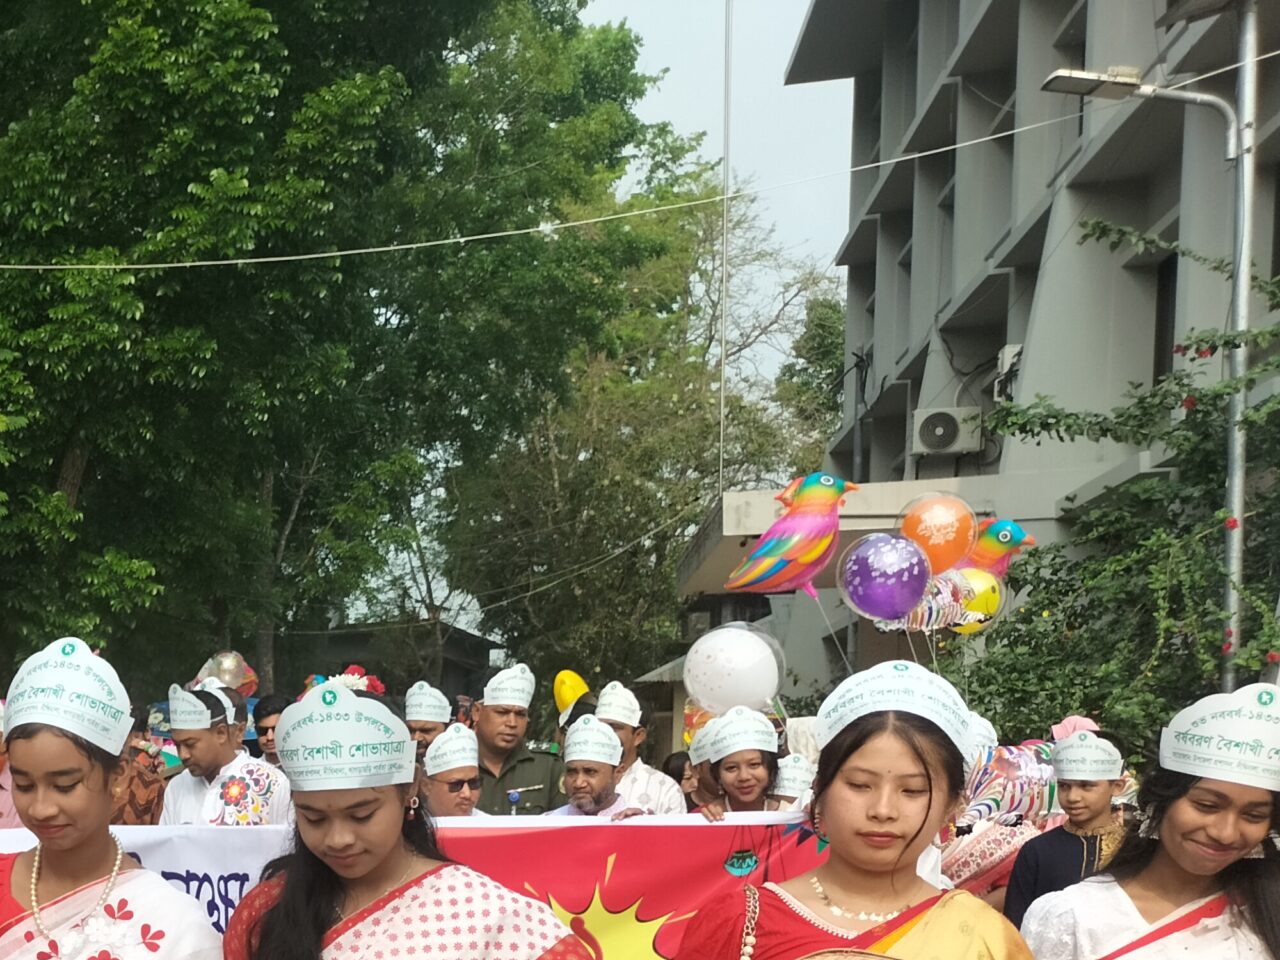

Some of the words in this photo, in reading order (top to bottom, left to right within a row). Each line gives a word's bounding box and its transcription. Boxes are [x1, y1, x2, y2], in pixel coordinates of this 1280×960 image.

[28, 684, 66, 700] বৈশাখী
[68, 691, 125, 724] শোভাযাত্রা
[301, 740, 344, 760] বৈশাখী
[349, 740, 406, 758] শোভাযাত্রা
[1174, 728, 1215, 749] বর্ষবরণ
[1216, 735, 1265, 758] বৈশাখী
